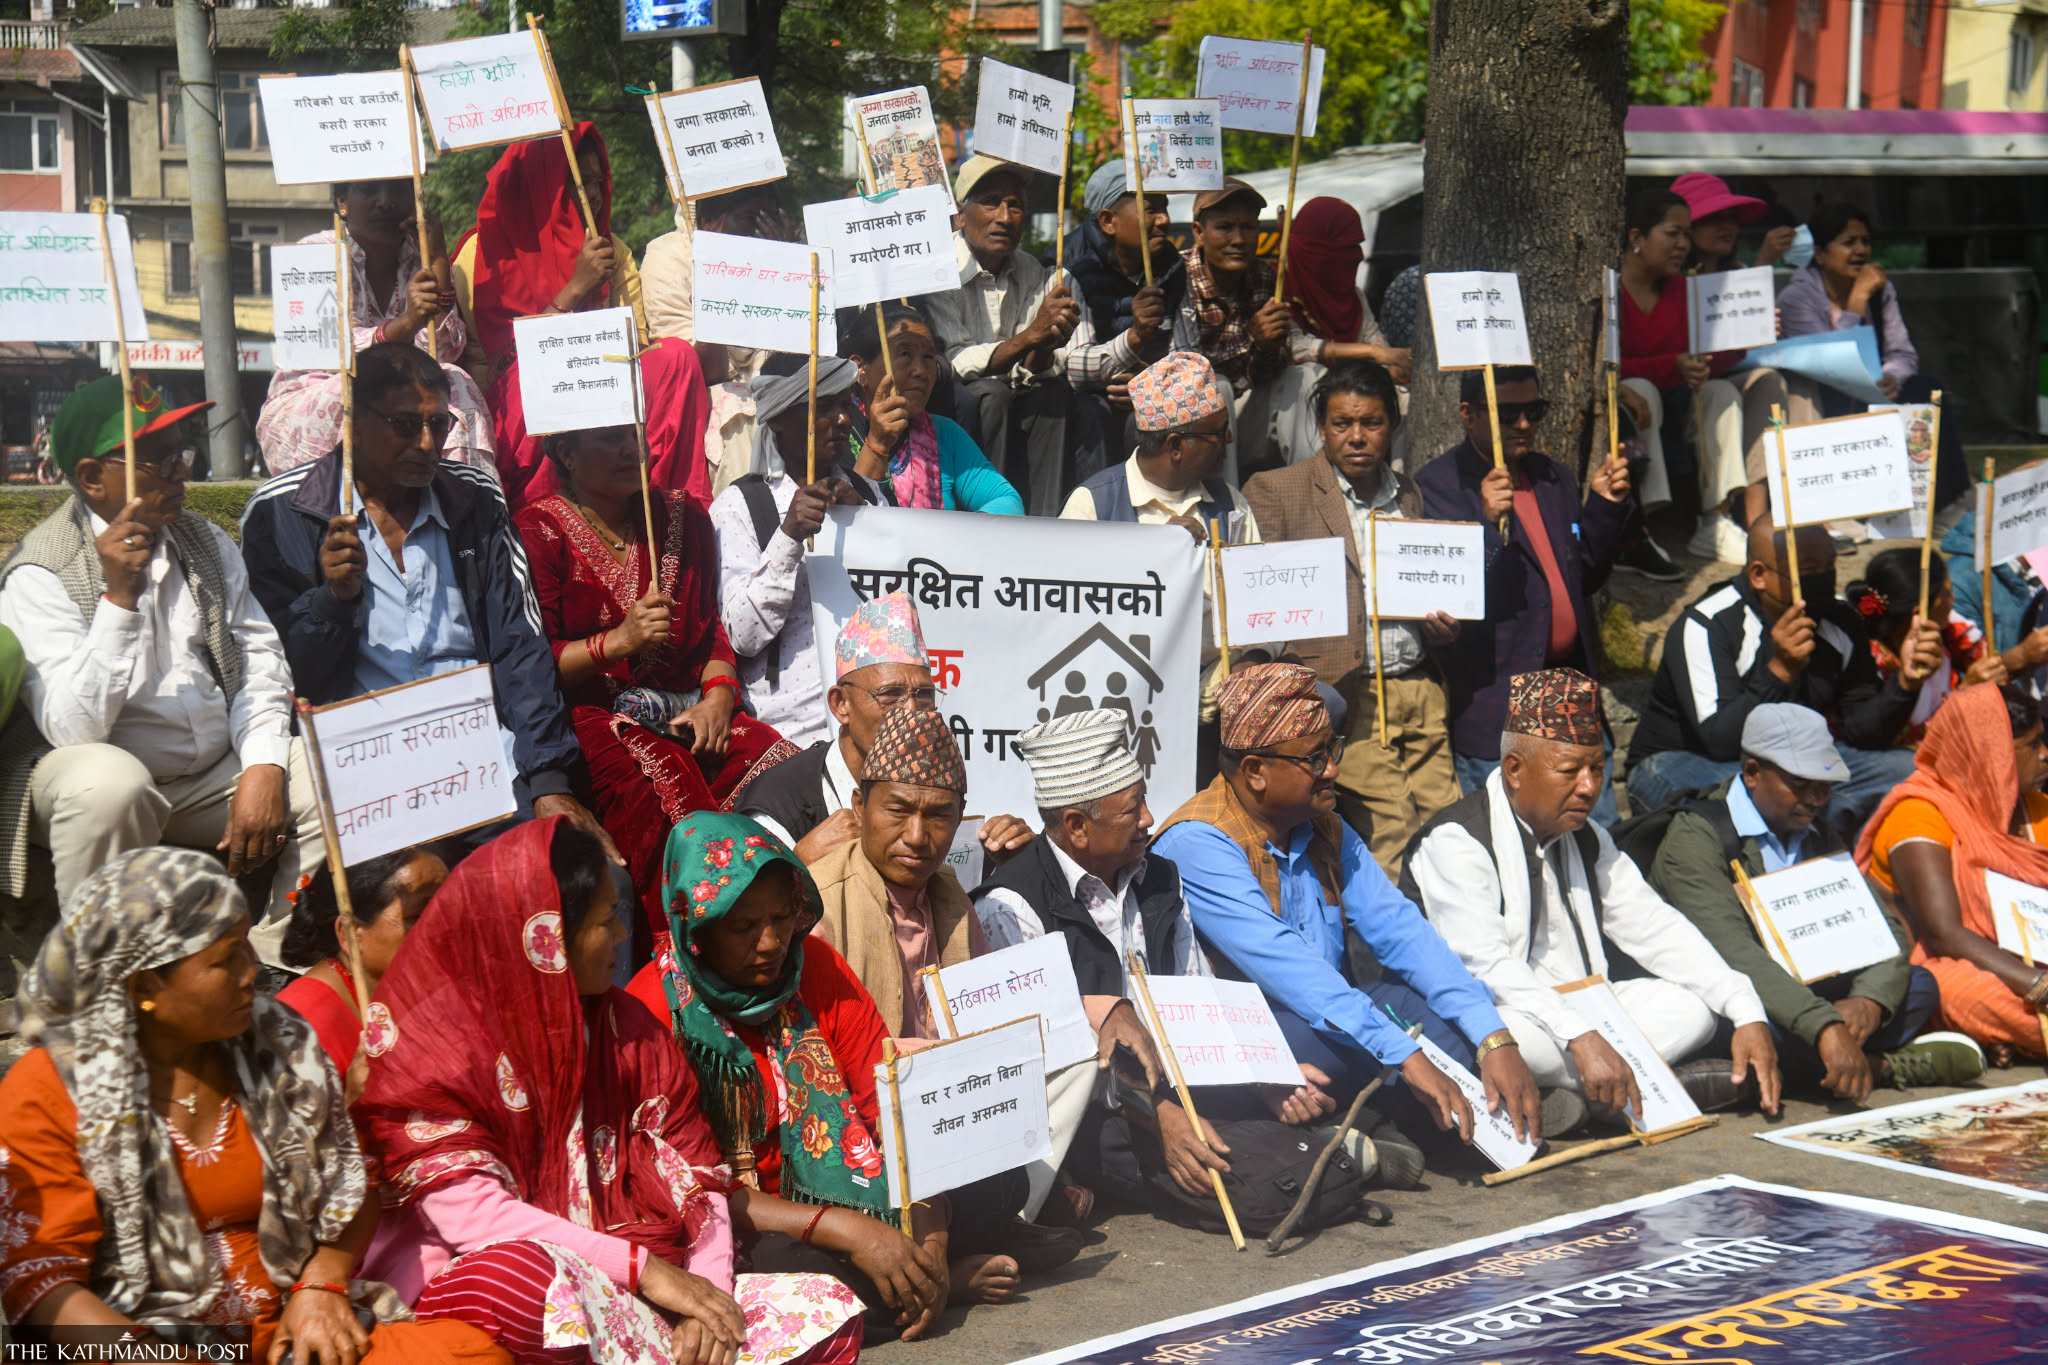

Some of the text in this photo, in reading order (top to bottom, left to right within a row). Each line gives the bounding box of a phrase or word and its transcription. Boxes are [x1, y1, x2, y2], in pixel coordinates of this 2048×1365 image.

[432, 60, 476, 91] हाम्रो
[294, 96, 333, 108] गरिबको
[339, 96, 354, 106] घर
[861, 101, 882, 114] जग्गा
[319, 118, 387, 131] कसरी सरकार
[443, 103, 485, 134] हाम्रो
[674, 115, 701, 130] जग्गा
[867, 114, 890, 128] जनता
[1153, 114, 1172, 125] नारा
[685, 142, 717, 157] जनता
[720, 130, 754, 150] कस्को
[1196, 157, 1212, 170] चोट
[846, 210, 926, 234] आवासको हक
[22, 225, 96, 252] अधिकार
[850, 244, 900, 264] ग्यारेण्टी
[903, 242, 922, 256] गर
[758, 269, 780, 283] घर
[289, 301, 304, 319] हक
[701, 299, 739, 315] कसरी
[742, 305, 782, 322] सरकार
[538, 337, 564, 354] सुरक्षित
[567, 335, 591, 346] घरबास
[566, 356, 600, 369] खेतियोग्य
[552, 381, 574, 394] जमिन
[1791, 447, 1824, 460] जग्गा
[1797, 474, 1833, 488] जनता
[1841, 464, 1877, 481] कस्को
[1398, 544, 1466, 558] आवासको हक
[1243, 565, 1320, 589] उठिबास
[1442, 574, 1458, 584] गर
[994, 570, 1166, 617] आवासको
[1247, 612, 1276, 629] बन्द
[1284, 609, 1314, 626] गर
[336, 697, 494, 768] जग्गा सरकारको
[334, 794, 398, 837] जनता
[405, 760, 470, 810] कस्को
[1770, 893, 1801, 912] जग्गा
[1787, 922, 1820, 941] जनता
[1823, 909, 1856, 929] कस्को
[948, 983, 1002, 1017] उठिबास
[1201, 1000, 1271, 1027] सरकारको
[1176, 1045, 1225, 1067] जनता
[921, 1063, 1023, 1106] घर र जमिन बिना
[932, 1098, 1018, 1136] जीवन असम्भव
[1648, 1236, 1815, 1277] लागि
[1142, 1343, 1222, 1365] भूमि
[1231, 1299, 1387, 1339] आवासको
[1362, 1267, 1491, 1306] अधिकार
